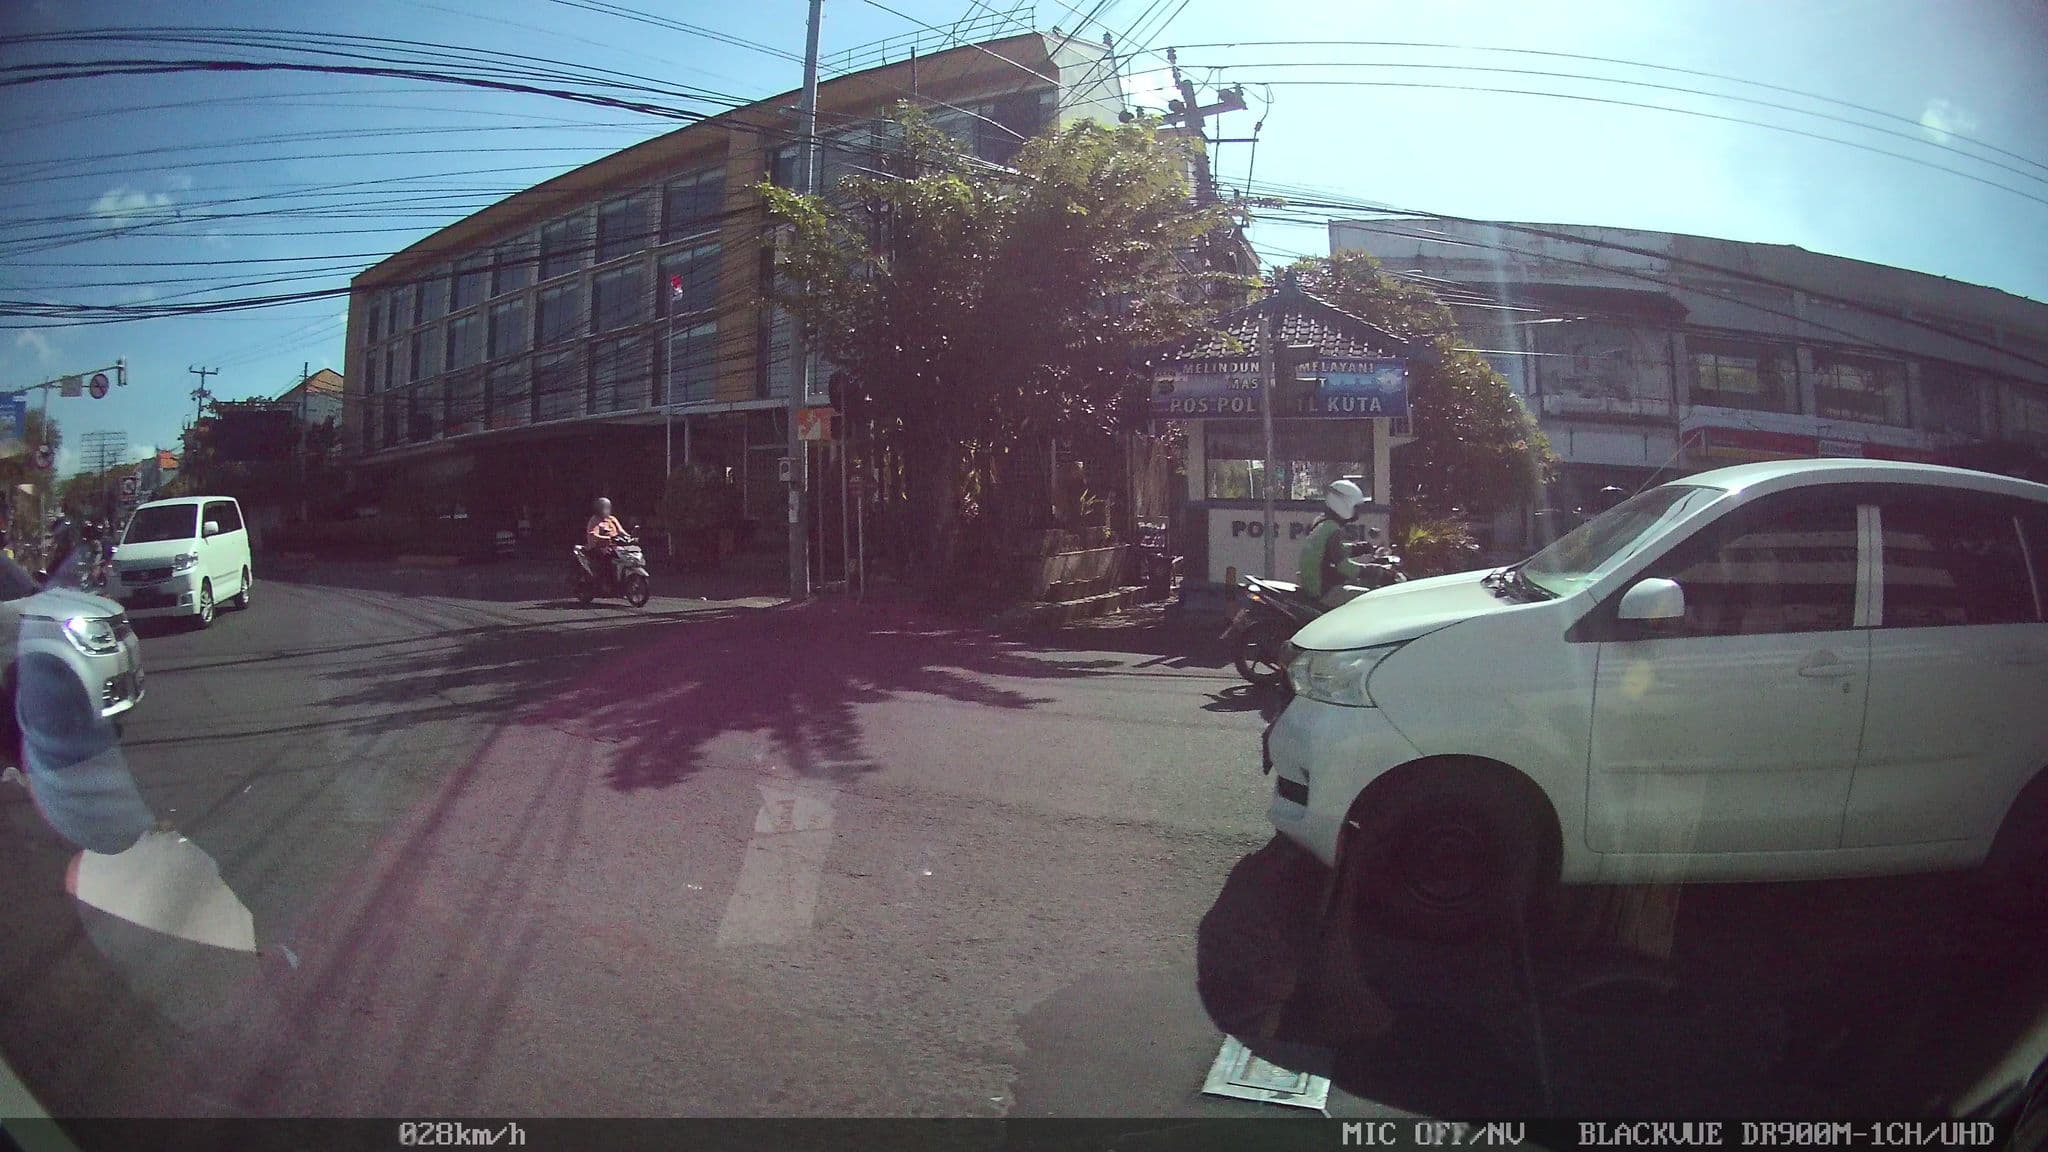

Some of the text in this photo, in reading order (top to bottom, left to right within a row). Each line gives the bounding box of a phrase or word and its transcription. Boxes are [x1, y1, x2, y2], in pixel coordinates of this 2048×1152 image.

[1183, 361, 1374, 374] MELINDUNI MELAYANI
[1170, 398, 1208, 413] POS
[1327, 397, 1382, 413] KUTA
